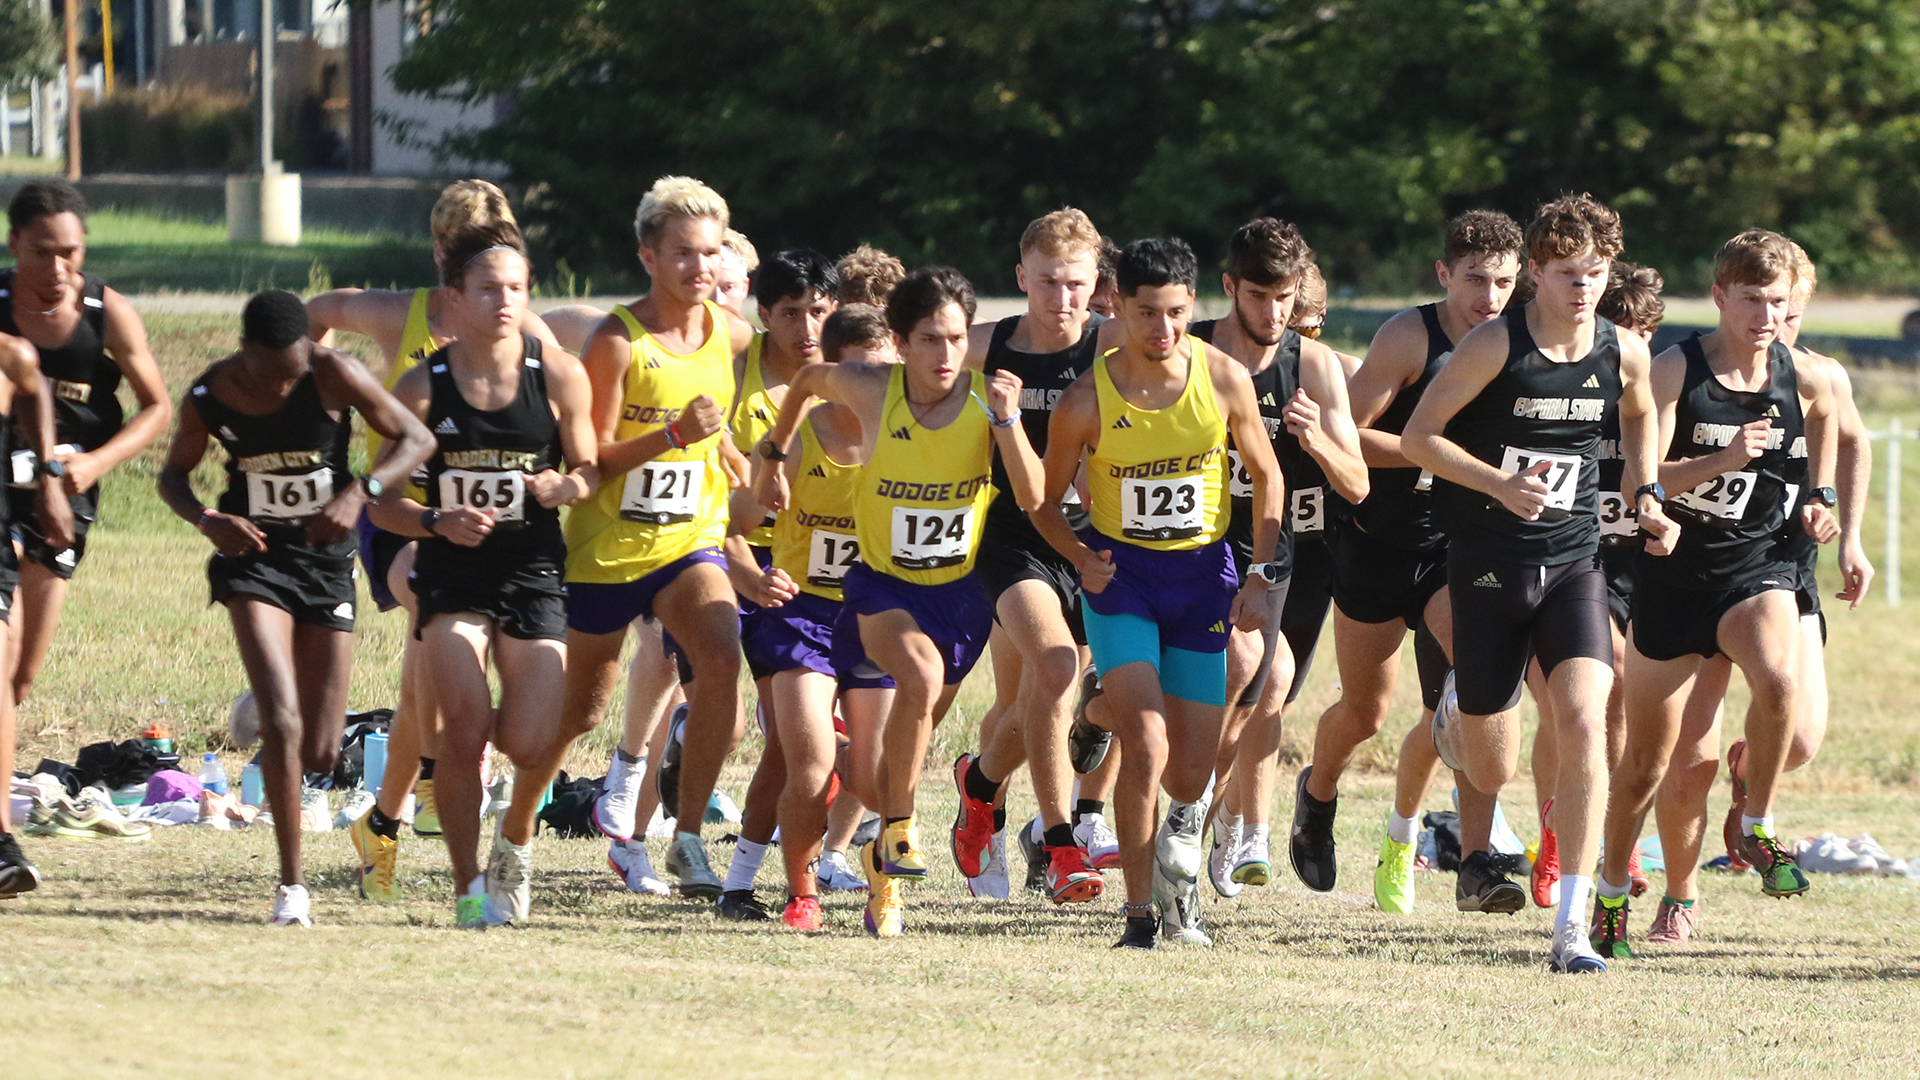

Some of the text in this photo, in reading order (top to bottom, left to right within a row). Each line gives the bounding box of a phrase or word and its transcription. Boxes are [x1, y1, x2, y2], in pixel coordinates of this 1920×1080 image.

[1567, 398, 1605, 422] STATE
[1109, 457, 1182, 479] DODGE
[261, 479, 317, 507] 161
[452, 476, 514, 508] 165
[641, 468, 691, 499] 121
[877, 478, 953, 502] DODGE
[1687, 475, 1747, 505] 29
[1133, 484, 1195, 516] 123
[905, 514, 965, 545] 124
[822, 537, 860, 567] 12
